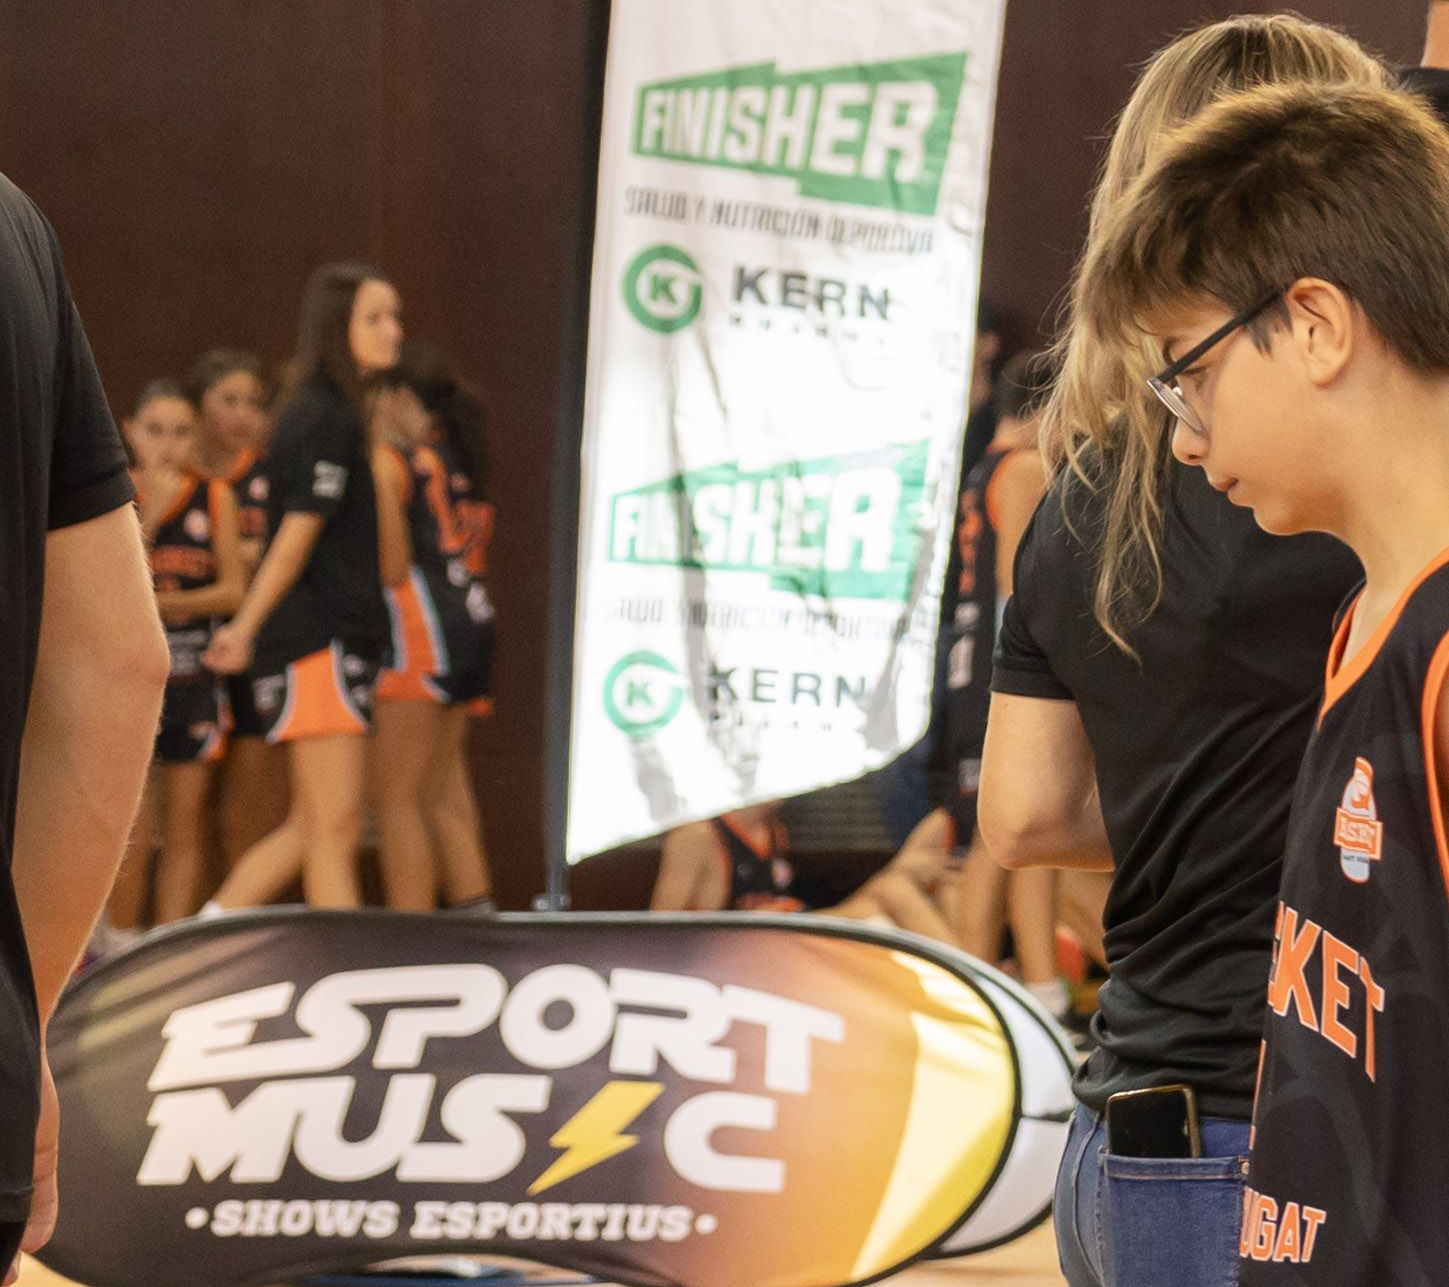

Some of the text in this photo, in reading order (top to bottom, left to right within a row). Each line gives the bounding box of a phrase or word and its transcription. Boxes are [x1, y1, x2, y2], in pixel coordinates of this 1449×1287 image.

[639, 80, 940, 184] FINISHER
[732, 265, 890, 321] KERN
[708, 666, 867, 710] KERN
[146, 962, 846, 1094] ESPORT
[1267, 900, 1385, 1084] KET
[210, 1200, 693, 1244] SHOWS ESPORTIUS
